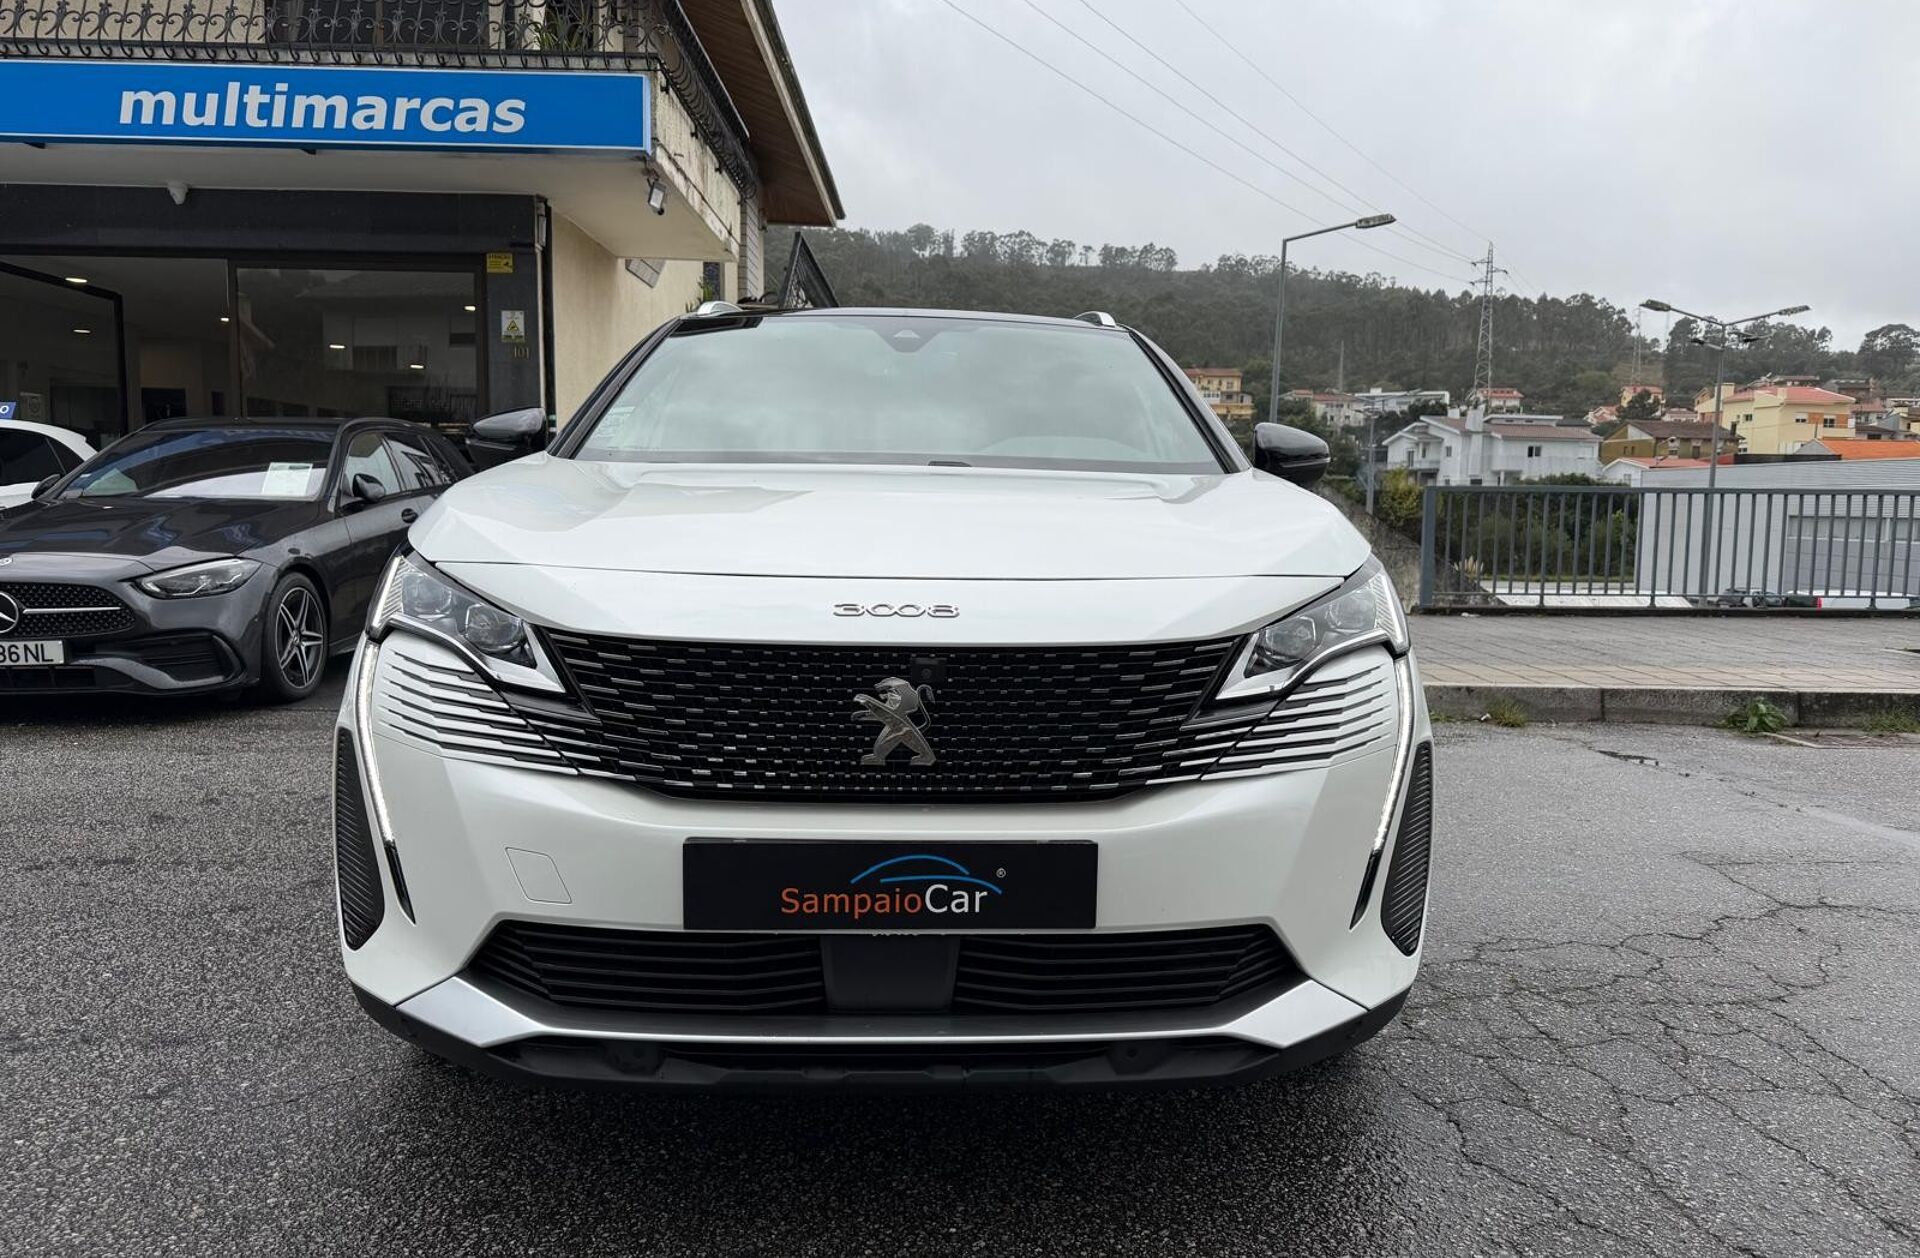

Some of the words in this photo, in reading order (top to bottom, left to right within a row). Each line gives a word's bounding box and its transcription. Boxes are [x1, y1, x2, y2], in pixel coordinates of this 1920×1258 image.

[119, 81, 527, 134] multimarcas
[833, 603, 960, 618] 3008
[23, 643, 54, 663] NL
[780, 883, 988, 919] SampaioCar
